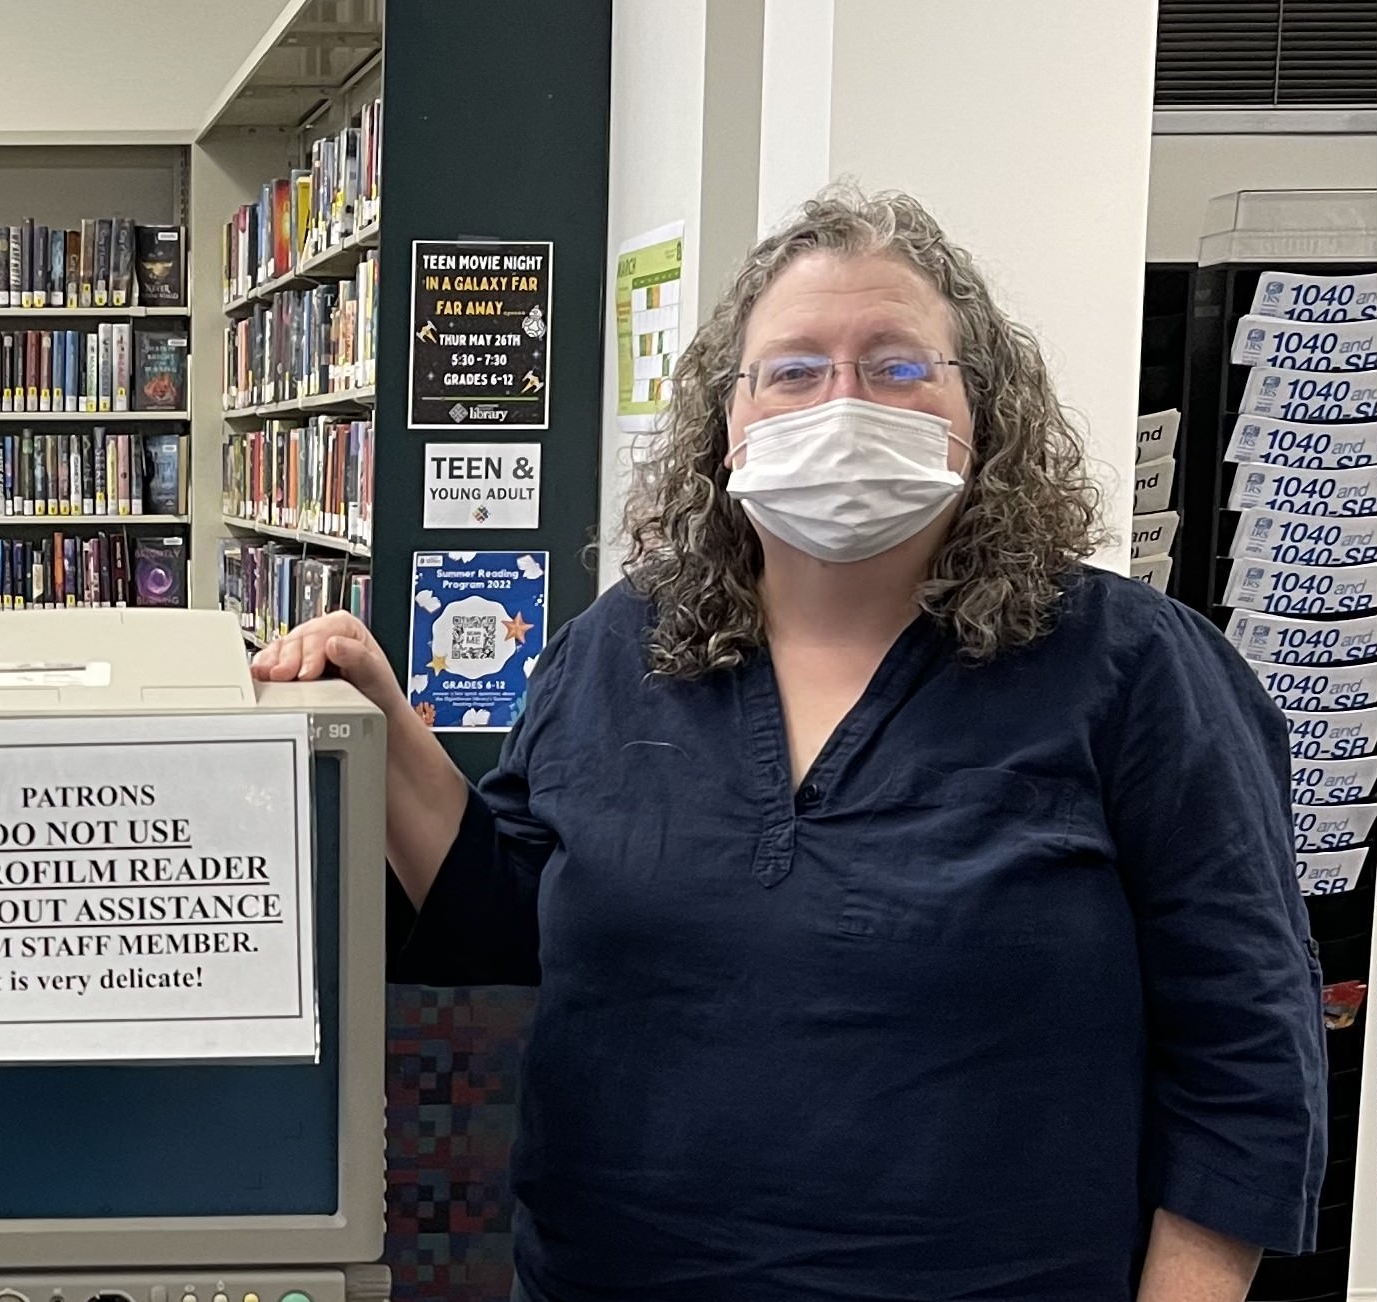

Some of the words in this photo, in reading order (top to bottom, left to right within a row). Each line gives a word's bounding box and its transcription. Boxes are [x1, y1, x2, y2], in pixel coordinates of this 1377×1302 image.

[422, 255, 456, 270] TEEN
[459, 255, 501, 270] MOVIE
[504, 256, 543, 271] NIGHT
[425, 276, 439, 291] IN
[442, 276, 452, 291] A
[454, 276, 508, 291] GALAXY
[511, 276, 538, 291] FAR
[1290, 284, 1354, 306] 1040
[435, 301, 463, 316] FAR
[439, 334, 467, 346] THUR
[469, 334, 492, 346] MAY
[494, 334, 521, 346] 26TH
[1273, 332, 1338, 354] 1040
[1339, 336, 1374, 353] and
[451, 353, 475, 366] 5:30
[484, 354, 508, 366] 7:30
[444, 373, 488, 386] GRADES
[490, 373, 514, 386] 6-12
[1288, 379, 1350, 402] 1040
[469, 406, 509, 422] library
[1137, 425, 1163, 443] nd
[1267, 429, 1331, 454] 1040
[1332, 438, 1365, 455] and
[431, 457, 502, 480] TEEN
[512, 457, 535, 480] &
[1134, 473, 1160, 491] nd
[1272, 476, 1336, 499] 1040
[1336, 481, 1370, 498] and
[429, 487, 482, 500] YOUNG
[486, 487, 536, 500] ADULT
[1279, 522, 1341, 546] 1040
[1341, 530, 1375, 546] and
[436, 569, 476, 580] Summer
[477, 569, 519, 581] Reading
[1271, 571, 1334, 595] 1040
[1334, 579, 1367, 595] and
[442, 580, 485, 591] Program
[487, 580, 512, 589] 2022
[1263, 593, 1372, 613] 1040-SR
[1277, 628, 1340, 648] 1040
[1340, 629, 1374, 647] and
[442, 680, 484, 690] GRADES
[485, 680, 507, 690] 6-12
[1266, 672, 1329, 695] 1040
[1329, 678, 1363, 695] and
[1273, 692, 1369, 711] 040-SR
[328, 724, 351, 738] 90
[1329, 723, 1363, 739] and
[1290, 737, 1368, 760] 40-SR
[1324, 772, 1358, 788] and
[21, 784, 155, 809] PATRONS
[46, 819, 117, 846] NOT
[128, 816, 192, 844] USE
[1316, 818, 1350, 833] and
[128, 854, 270, 884] READER
[1308, 864, 1342, 880] and
[75, 893, 283, 922] ASSISTANCE
[20, 935, 111, 959] STAFF
[118, 931, 259, 956] MEMBER.
[11, 969, 29, 992] is
[36, 973, 90, 996] very
[100, 965, 204, 991] delicate!
